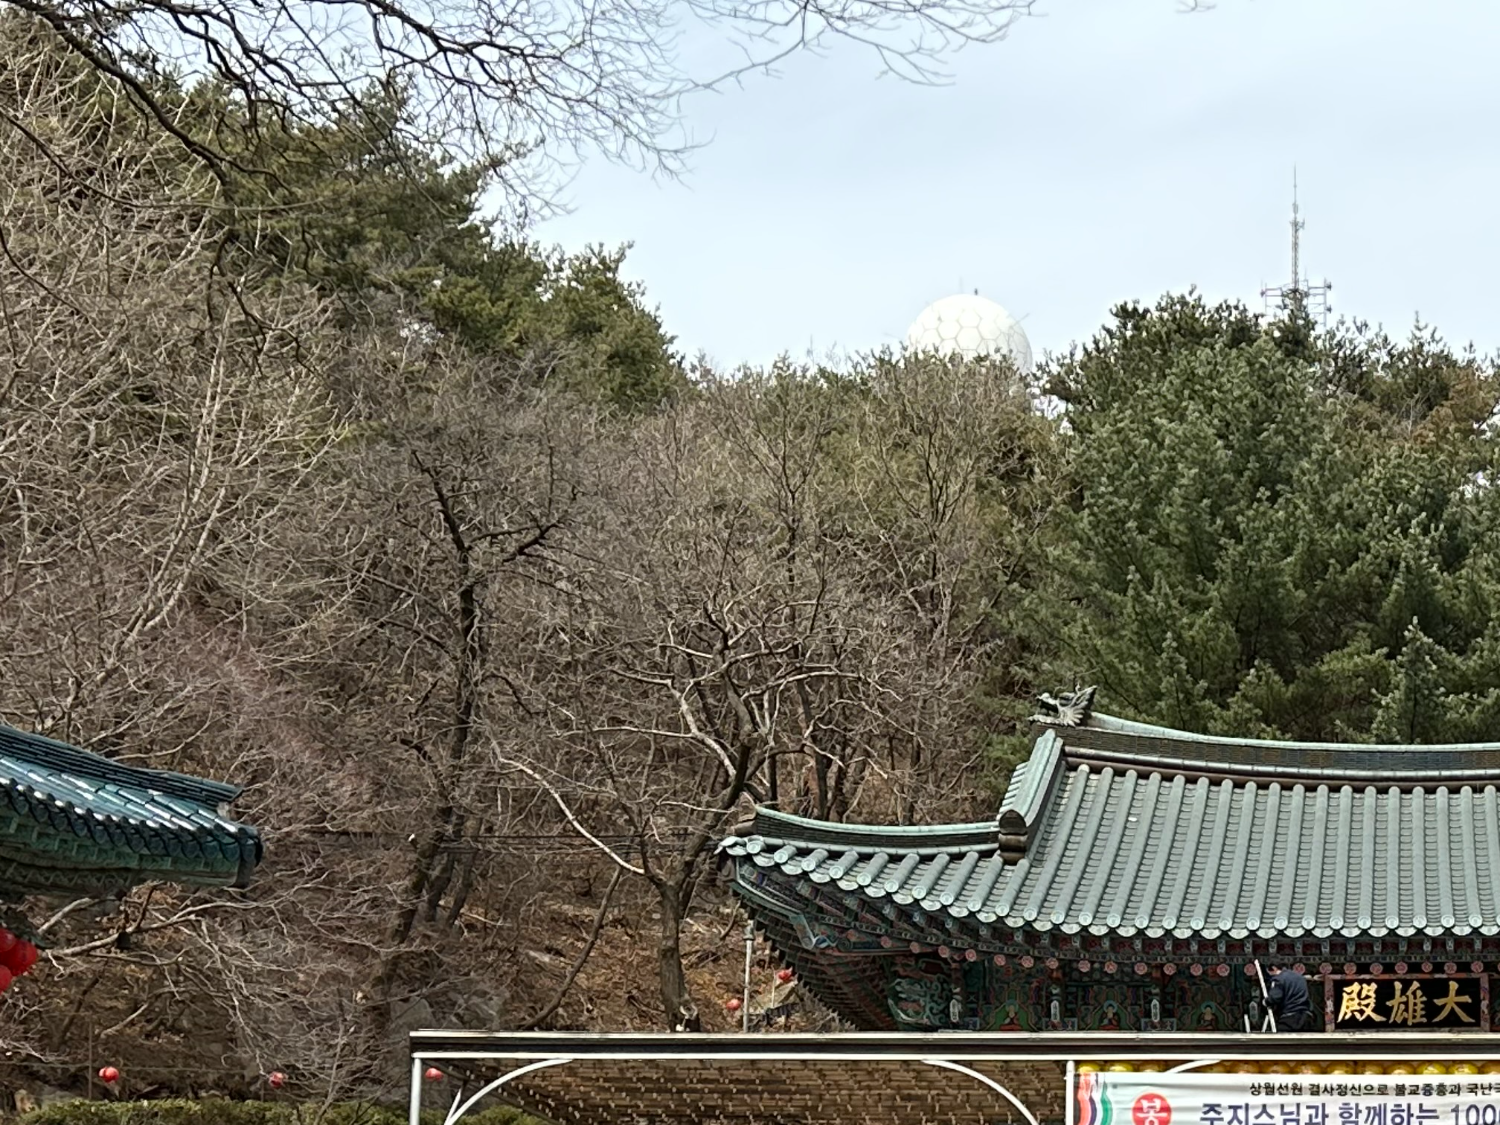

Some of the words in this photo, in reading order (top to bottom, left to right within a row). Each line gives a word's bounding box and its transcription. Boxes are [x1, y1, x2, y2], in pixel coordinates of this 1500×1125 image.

[1249, 1082, 1303, 1096] 상월선원
[1308, 1083, 1390, 1096] 결사정신으로
[1395, 1082, 1461, 1096] 불교중흥과
